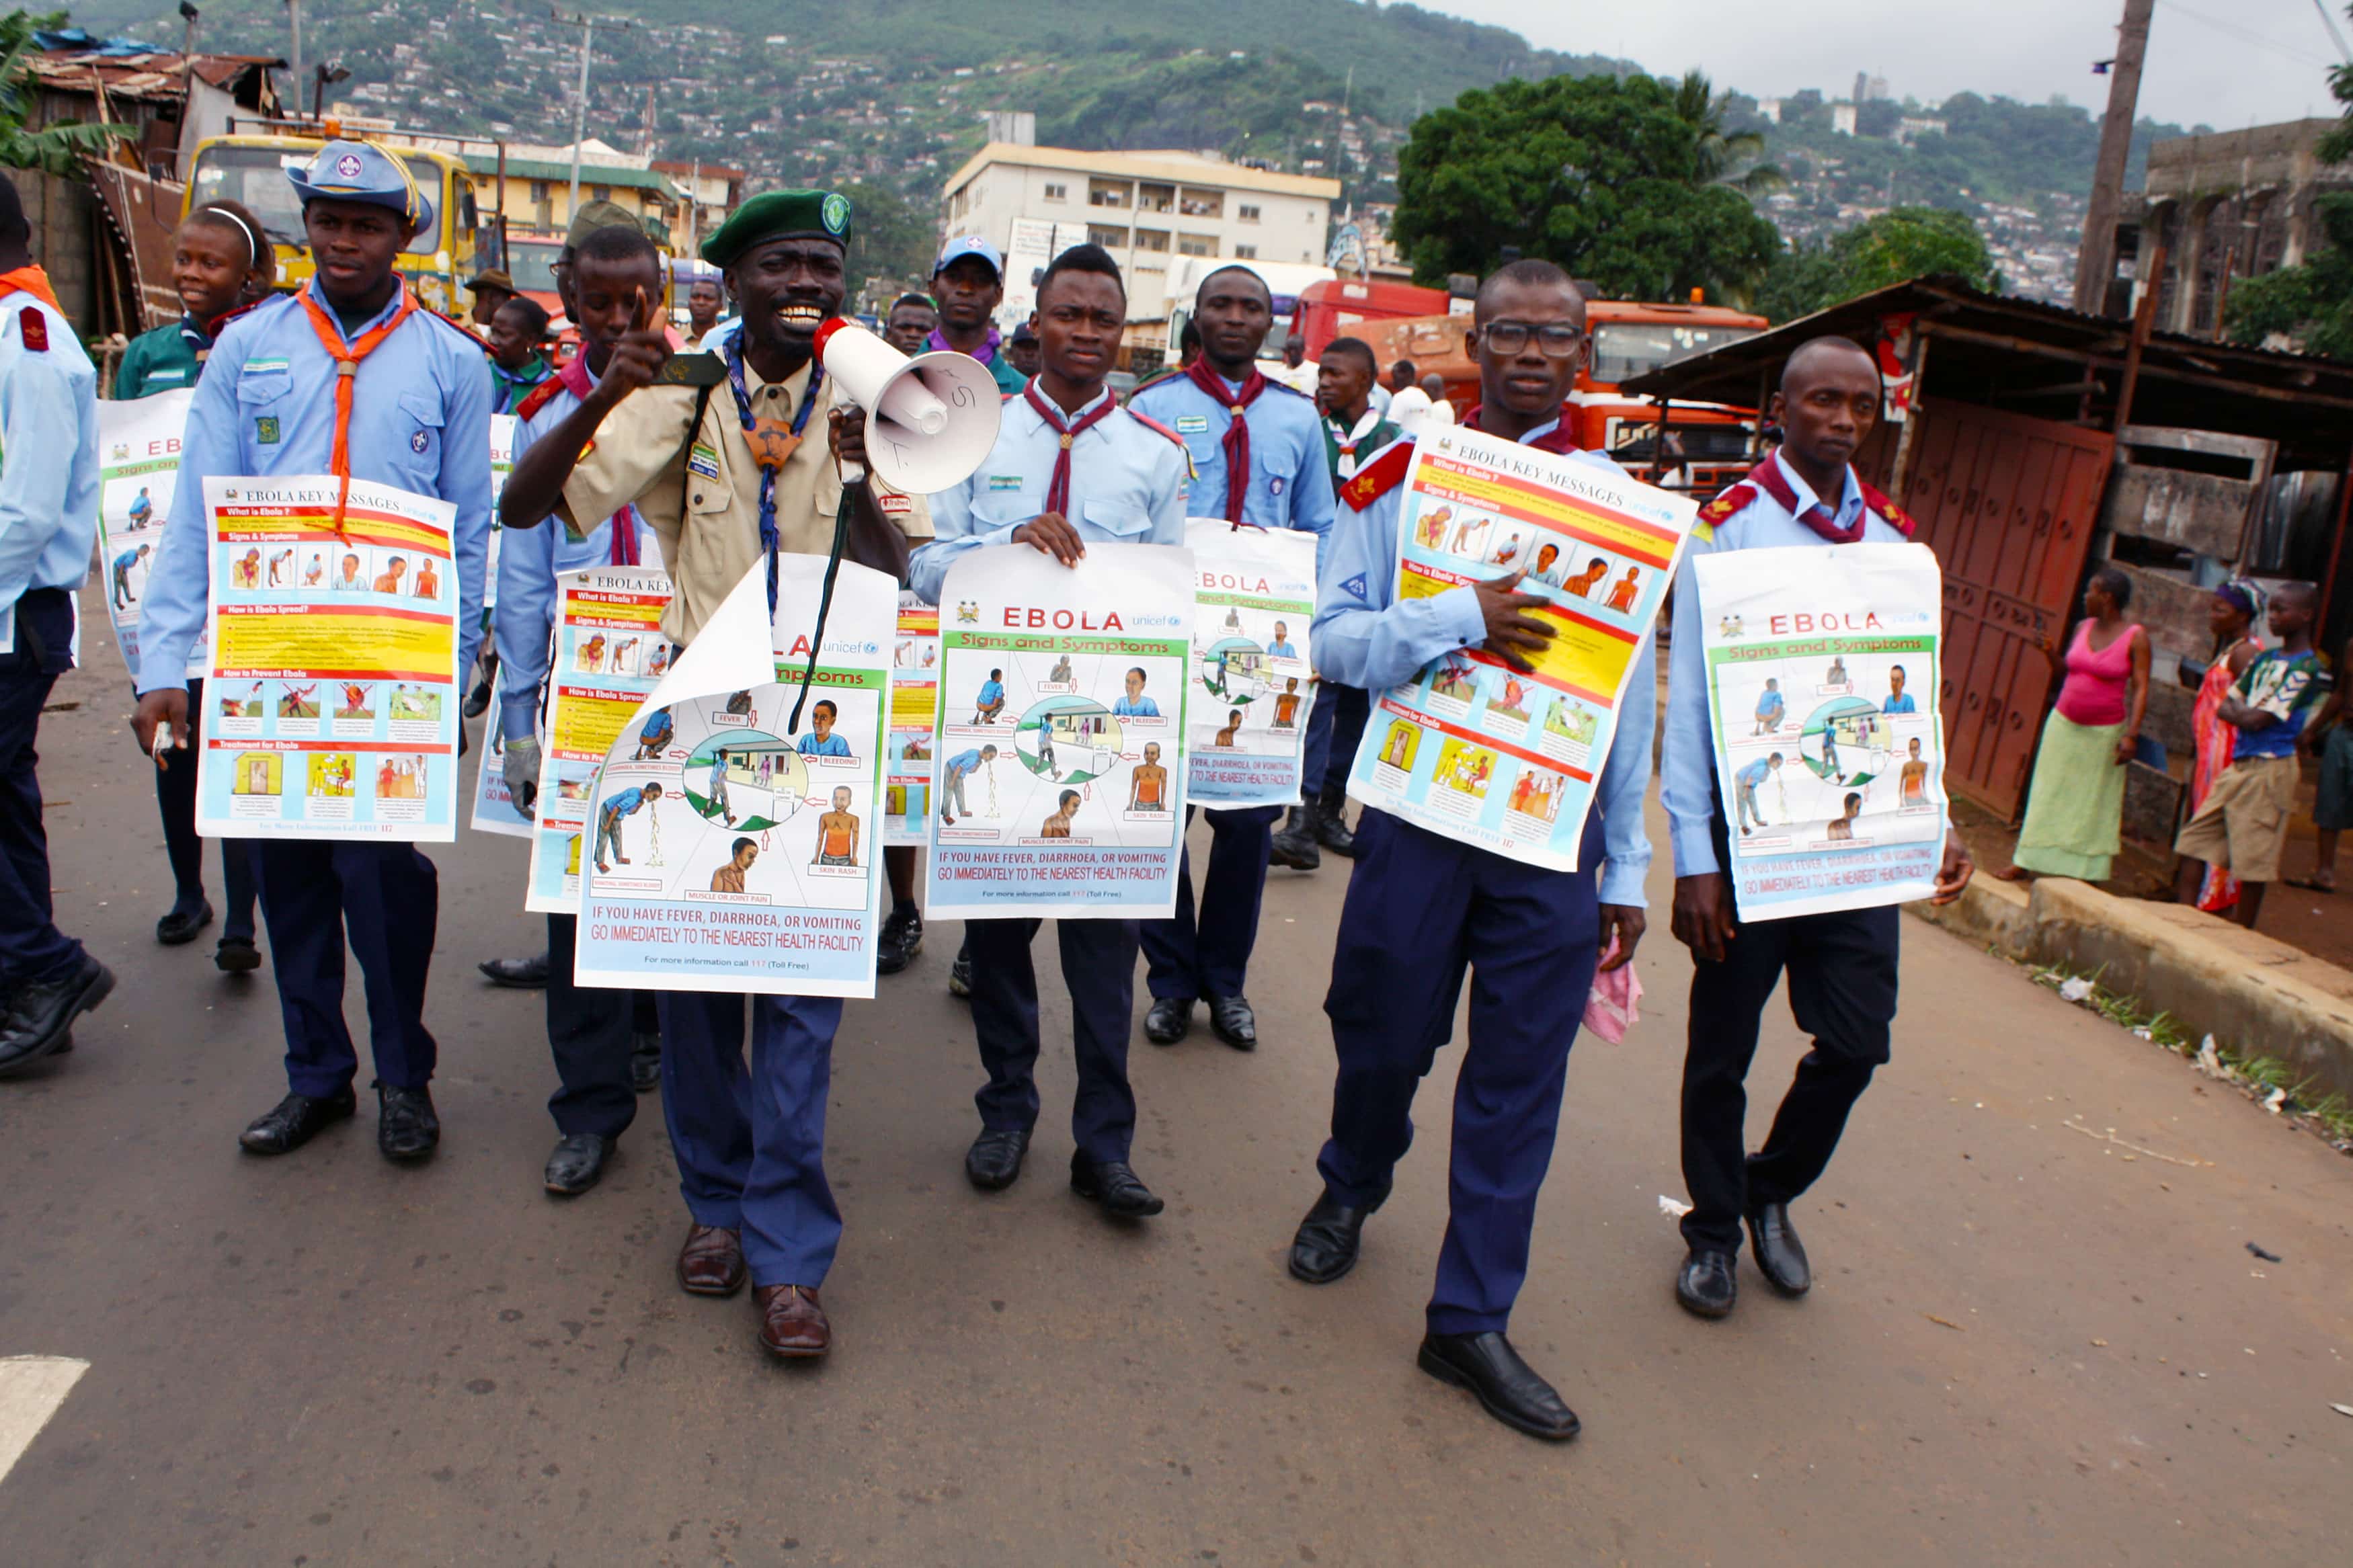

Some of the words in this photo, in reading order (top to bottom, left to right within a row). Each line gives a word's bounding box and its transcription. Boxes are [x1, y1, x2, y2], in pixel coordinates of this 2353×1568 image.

[117, 463, 152, 476] Signs
[1433, 457, 1456, 470] What
[1457, 463, 1465, 472] is
[1466, 465, 1490, 481] Ebola
[1459, 446, 1508, 470] EBOLA
[1513, 460, 1546, 479] KEY
[1547, 472, 1624, 507] MESSAGES
[247, 491, 294, 503] EBOLA
[299, 491, 324, 501] KEY
[329, 491, 399, 511] MSSAGES
[1423, 484, 1447, 498] Signs
[1448, 490, 1455, 499] &
[1458, 493, 1501, 511] Symptoms
[227, 508, 249, 516] What
[228, 533, 251, 542] Signs
[260, 533, 298, 542] Symptoms
[1195, 571, 1270, 594] BOLA
[1431, 569, 1453, 583] Ebola
[598, 577, 643, 590] EBOLA
[647, 581, 672, 592] KEY
[577, 592, 598, 601] What
[1230, 594, 1301, 610] Symptoms
[278, 606, 308, 614] Spread?
[575, 617, 596, 626] Signs
[606, 620, 645, 629] Symptoms
[1004, 607, 1124, 630] EBOLA
[1133, 616, 1166, 626] unicef
[1769, 612, 1883, 635] EBOLA
[824, 641, 861, 653] unicef
[961, 633, 1008, 649] Signs
[1015, 636, 1054, 649] and
[1062, 637, 1168, 653] Symptoms
[1728, 646, 1780, 659] Signs
[1787, 639, 1827, 655] and
[1833, 639, 1922, 653] Symptoms
[596, 691, 616, 700] Ebola
[720, 714, 740, 723] FEVER
[1420, 713, 1441, 729] Ebola
[220, 741, 260, 749] Treatment
[262, 741, 274, 749] for
[824, 757, 857, 766] BLEEDING
[485, 789, 496, 800] GO
[939, 852, 948, 862] IF
[951, 852, 971, 863] YOU
[974, 853, 1000, 862] HAVE
[1002, 854, 1035, 864] FEVER,
[1039, 854, 1099, 864] DIARRHOEA,
[1102, 854, 1115, 863] OR
[1118, 854, 1166, 863] VOMITING
[938, 867, 952, 880] GO
[955, 867, 1014, 880] IMMEDIATELY
[1016, 868, 1028, 880] TO
[1031, 868, 1047, 880] THE
[1049, 868, 1091, 880] NEAREST
[1094, 867, 1127, 880] HEALTH
[1129, 867, 1167, 880] FACILITY
[593, 906, 603, 917] IF
[606, 907, 629, 919] YOU
[633, 909, 664, 921] HAVE
[668, 910, 706, 923] FEVER,
[710, 911, 780, 927] DIARRHOEA,
[785, 915, 800, 927] OR
[804, 916, 861, 931] VOMITING
[592, 925, 608, 940] GO
[610, 925, 680, 944] IMMEDIATELY
[683, 928, 697, 944] TO
[701, 929, 721, 945] THE
[724, 930, 772, 948] NEAREST
[775, 932, 815, 950] HEALTH
[819, 934, 863, 952] FACILITY
[684, 957, 732, 966] information
[734, 958, 749, 966] call
[768, 960, 785, 969] (Toll
[787, 961, 809, 971] Free)
